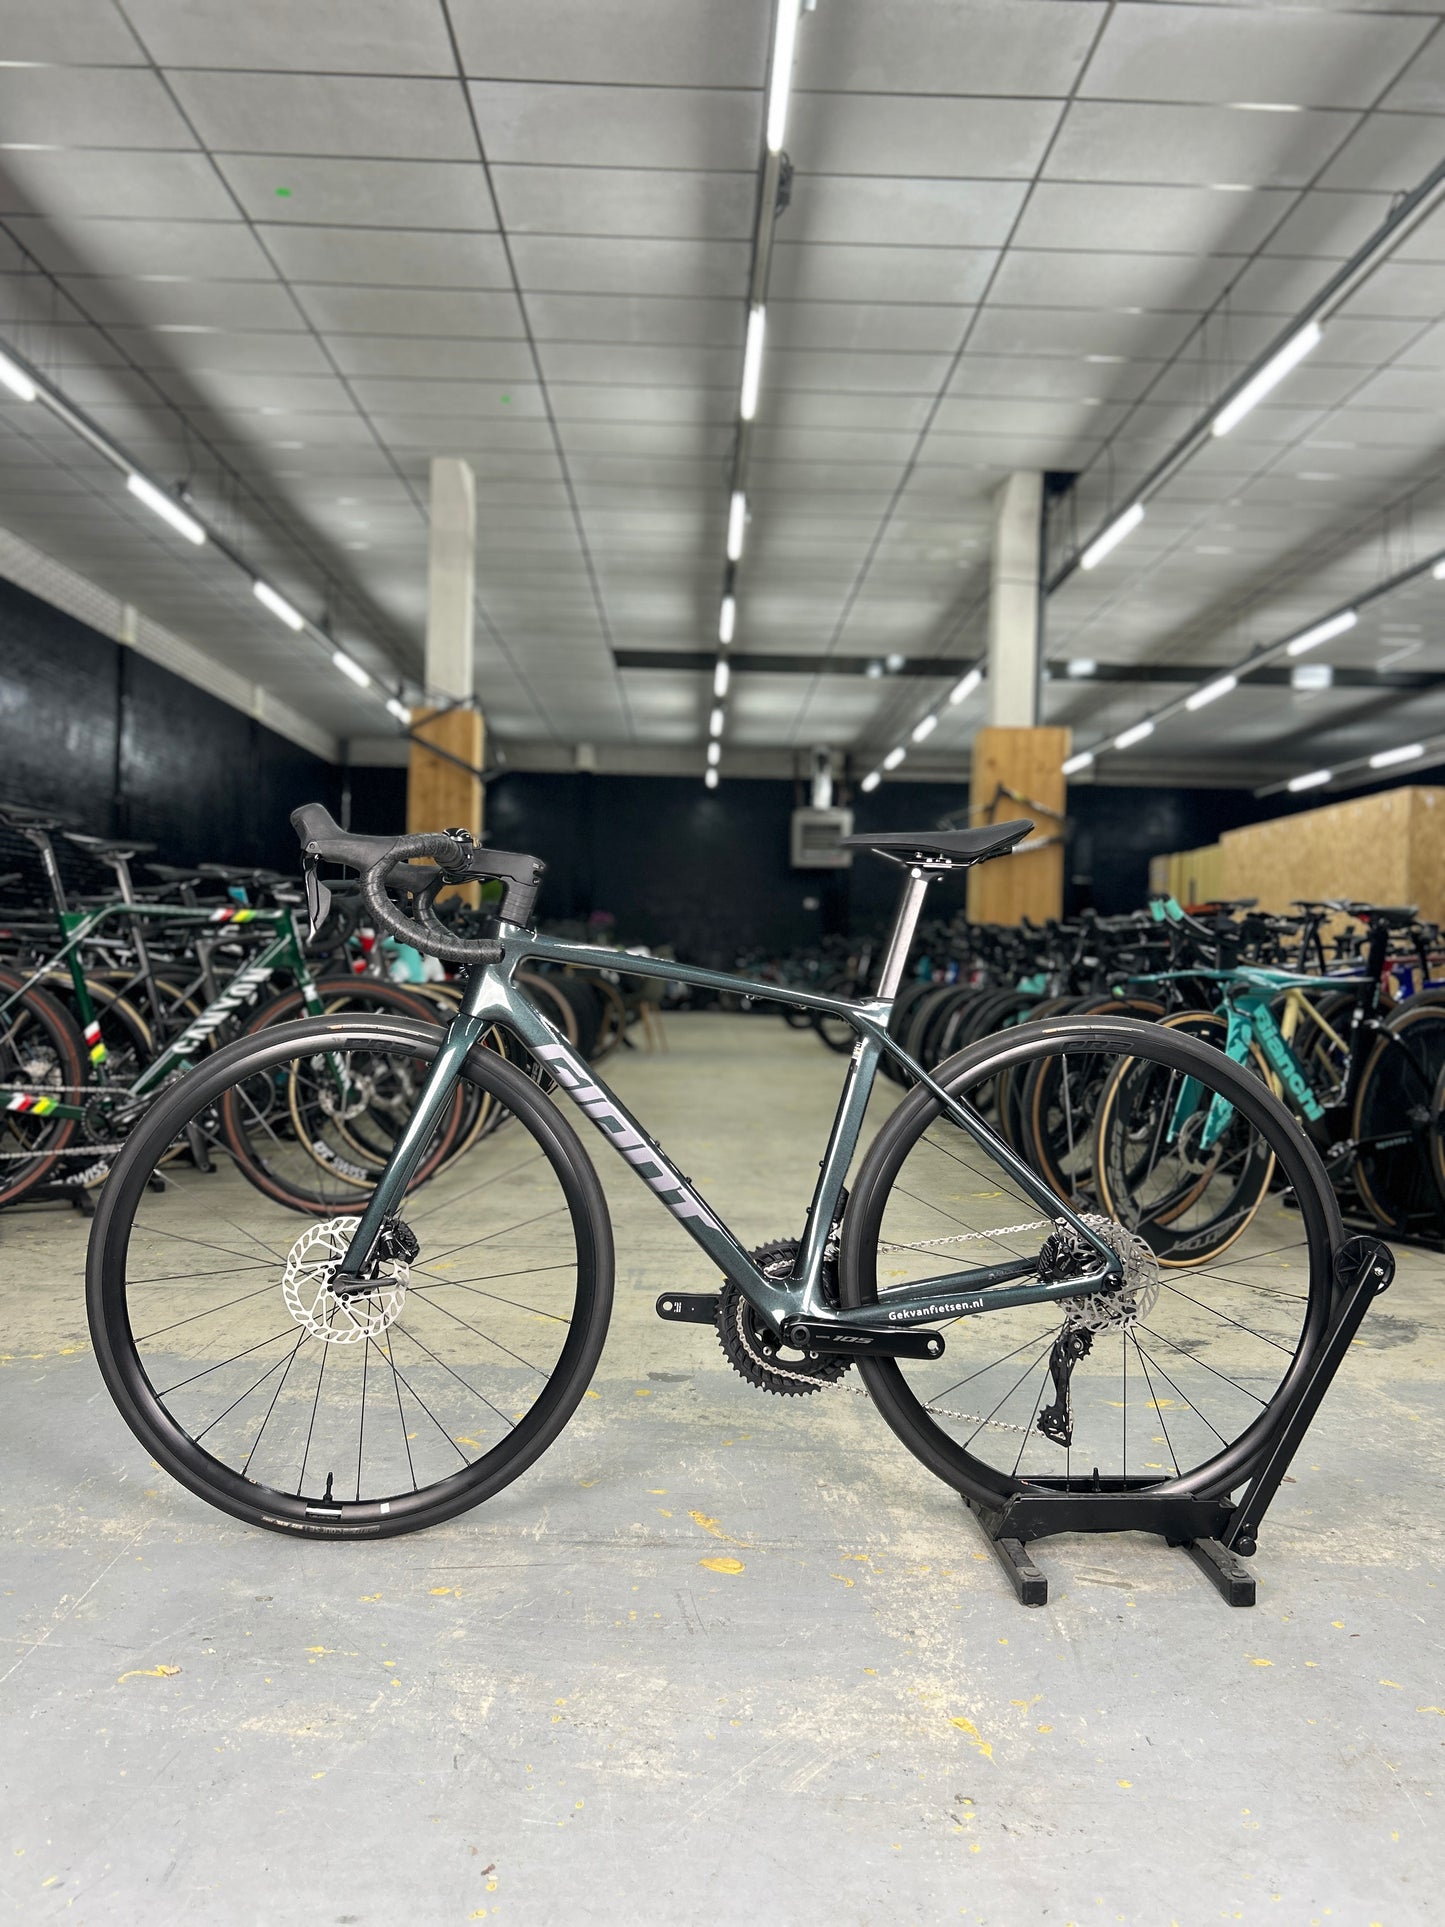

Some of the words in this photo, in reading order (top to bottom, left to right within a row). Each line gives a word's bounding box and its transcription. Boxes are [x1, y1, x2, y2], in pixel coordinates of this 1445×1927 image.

[172, 967, 274, 1053] CANYON
[1252, 1004, 1325, 1122] Bianchi
[531, 1043, 724, 1235] GIANT
[332, 1156, 369, 1181] SWISS
[888, 1298, 984, 1321] Gekvanfietsen.nl
[832, 1335, 875, 1345] 105
